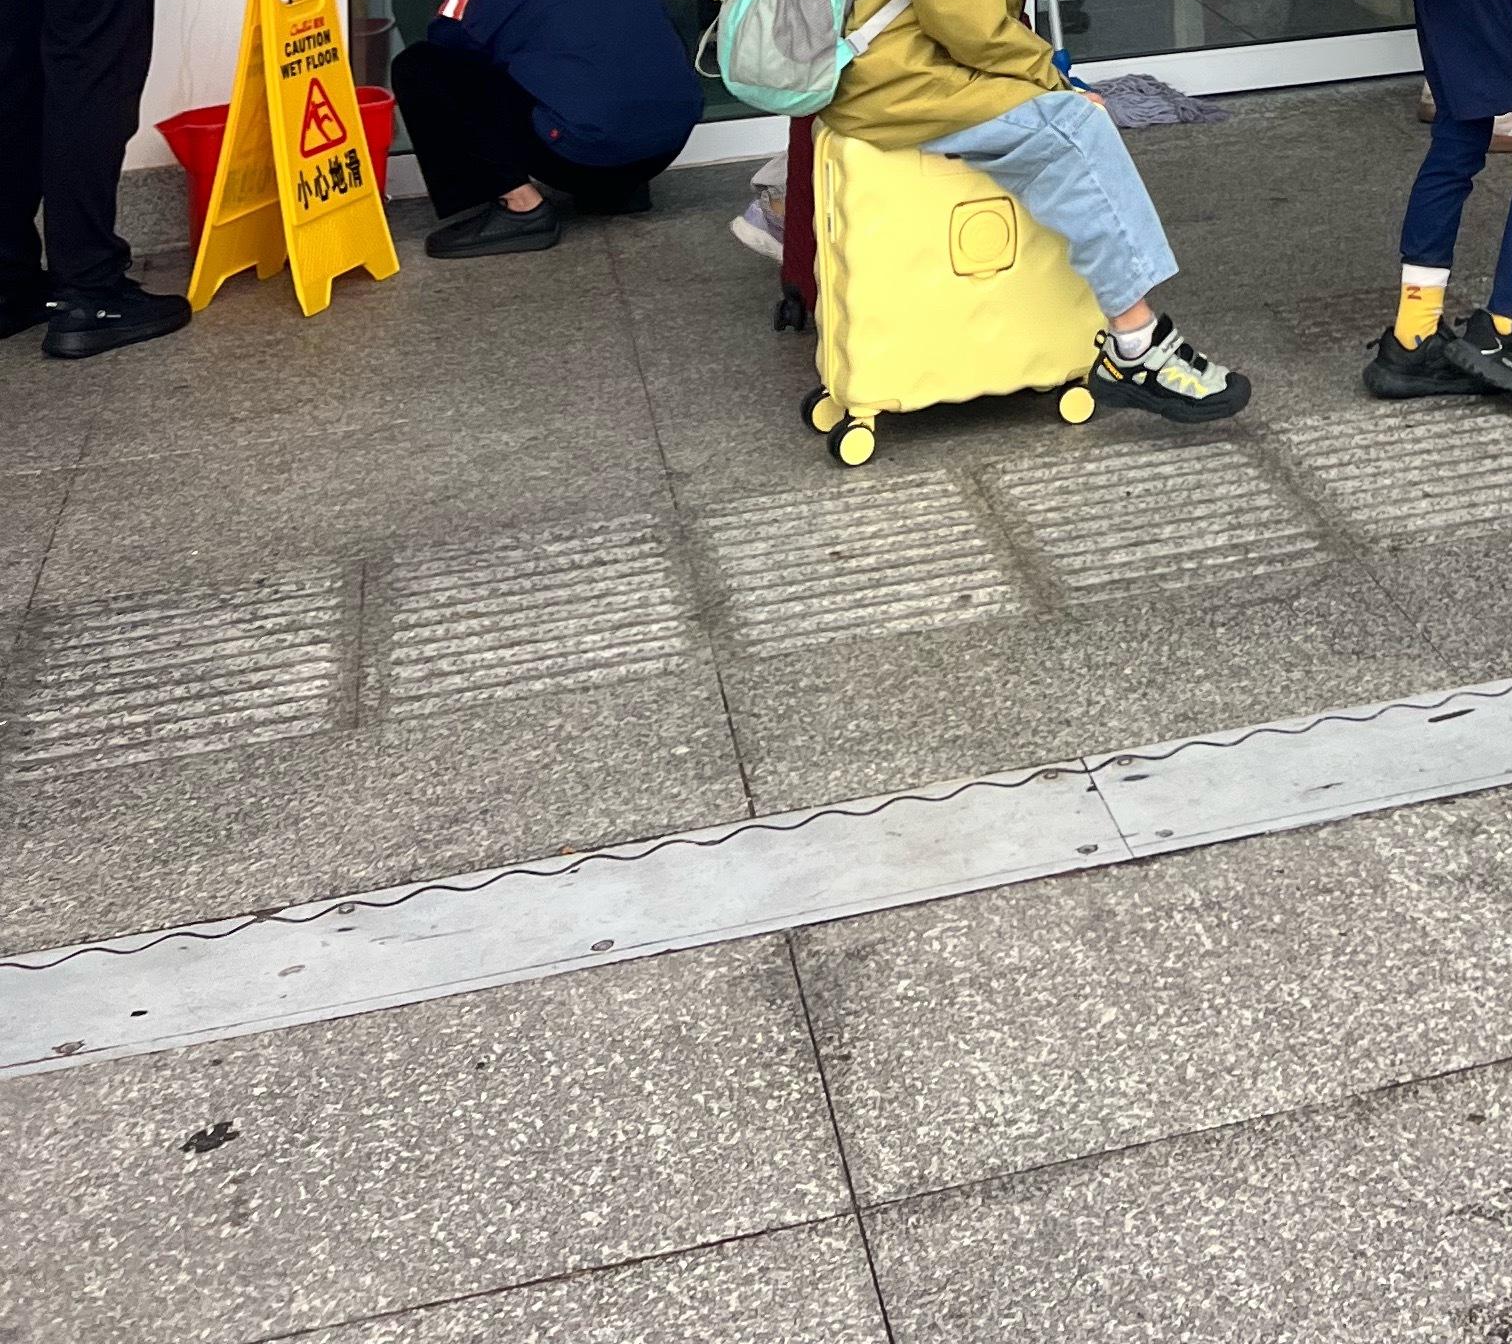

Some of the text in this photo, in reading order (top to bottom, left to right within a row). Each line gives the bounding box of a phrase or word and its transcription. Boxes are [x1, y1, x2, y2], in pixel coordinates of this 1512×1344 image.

[285, 28, 331, 57] CAUTION
[280, 47, 340, 80] WET FLOOR
[297, 148, 363, 210] 小心地滑
